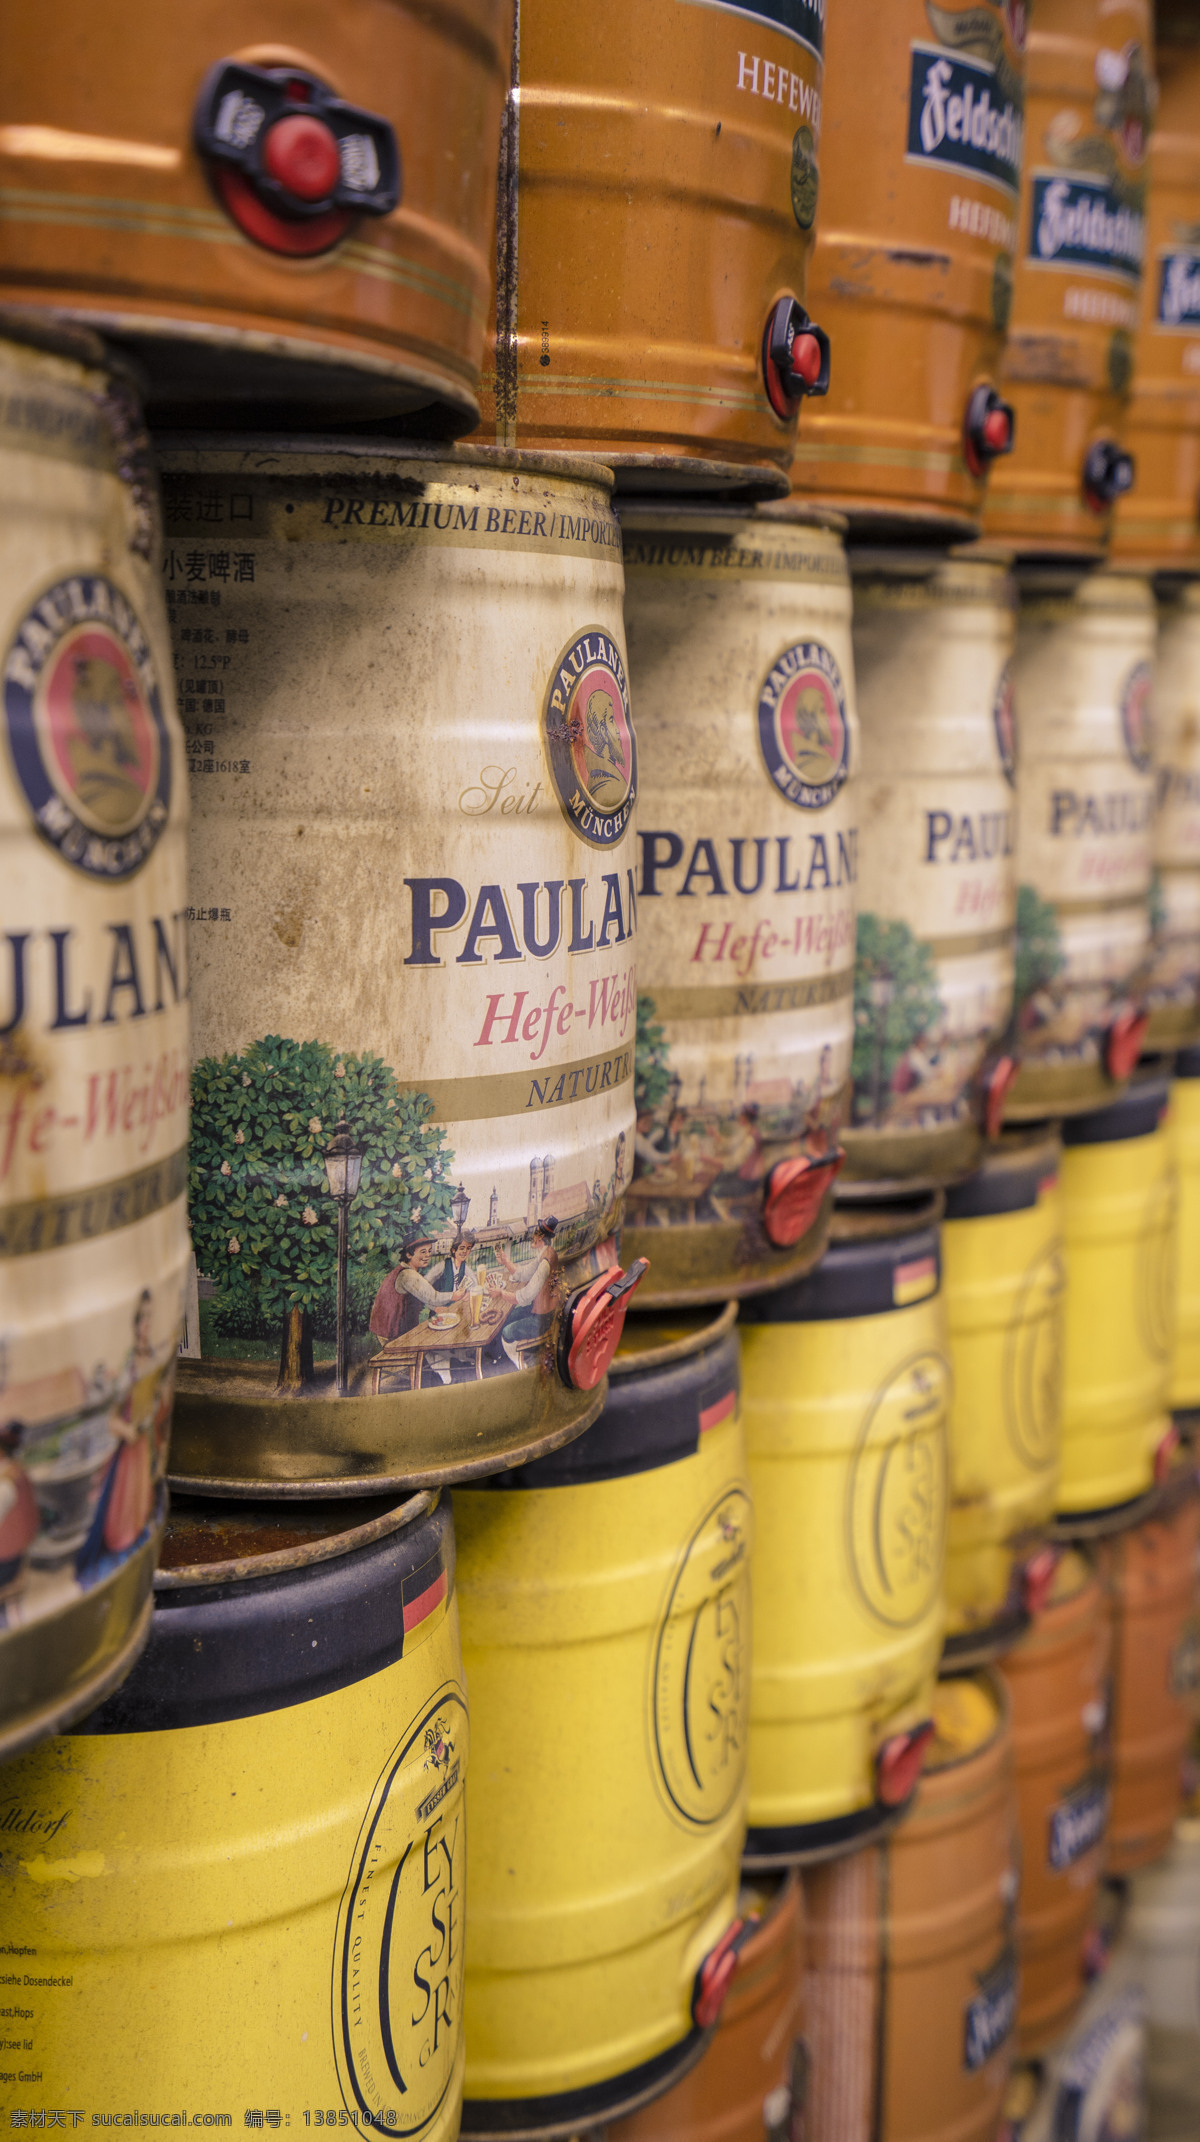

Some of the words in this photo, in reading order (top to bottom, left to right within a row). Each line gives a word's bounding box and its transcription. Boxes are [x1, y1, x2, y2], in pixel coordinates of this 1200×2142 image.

[322, 498, 480, 531] PREMIUM
[162, 550, 256, 584] 小麦啤酒
[551, 631, 631, 717] PAULANER
[459, 765, 543, 816] Seit
[357, 1844, 382, 1920] FINEST
[23, 1974, 73, 1987] Dosendeckel
[352, 1936, 363, 2027] QUALITY
[18, 2071, 43, 2082] GmbH
